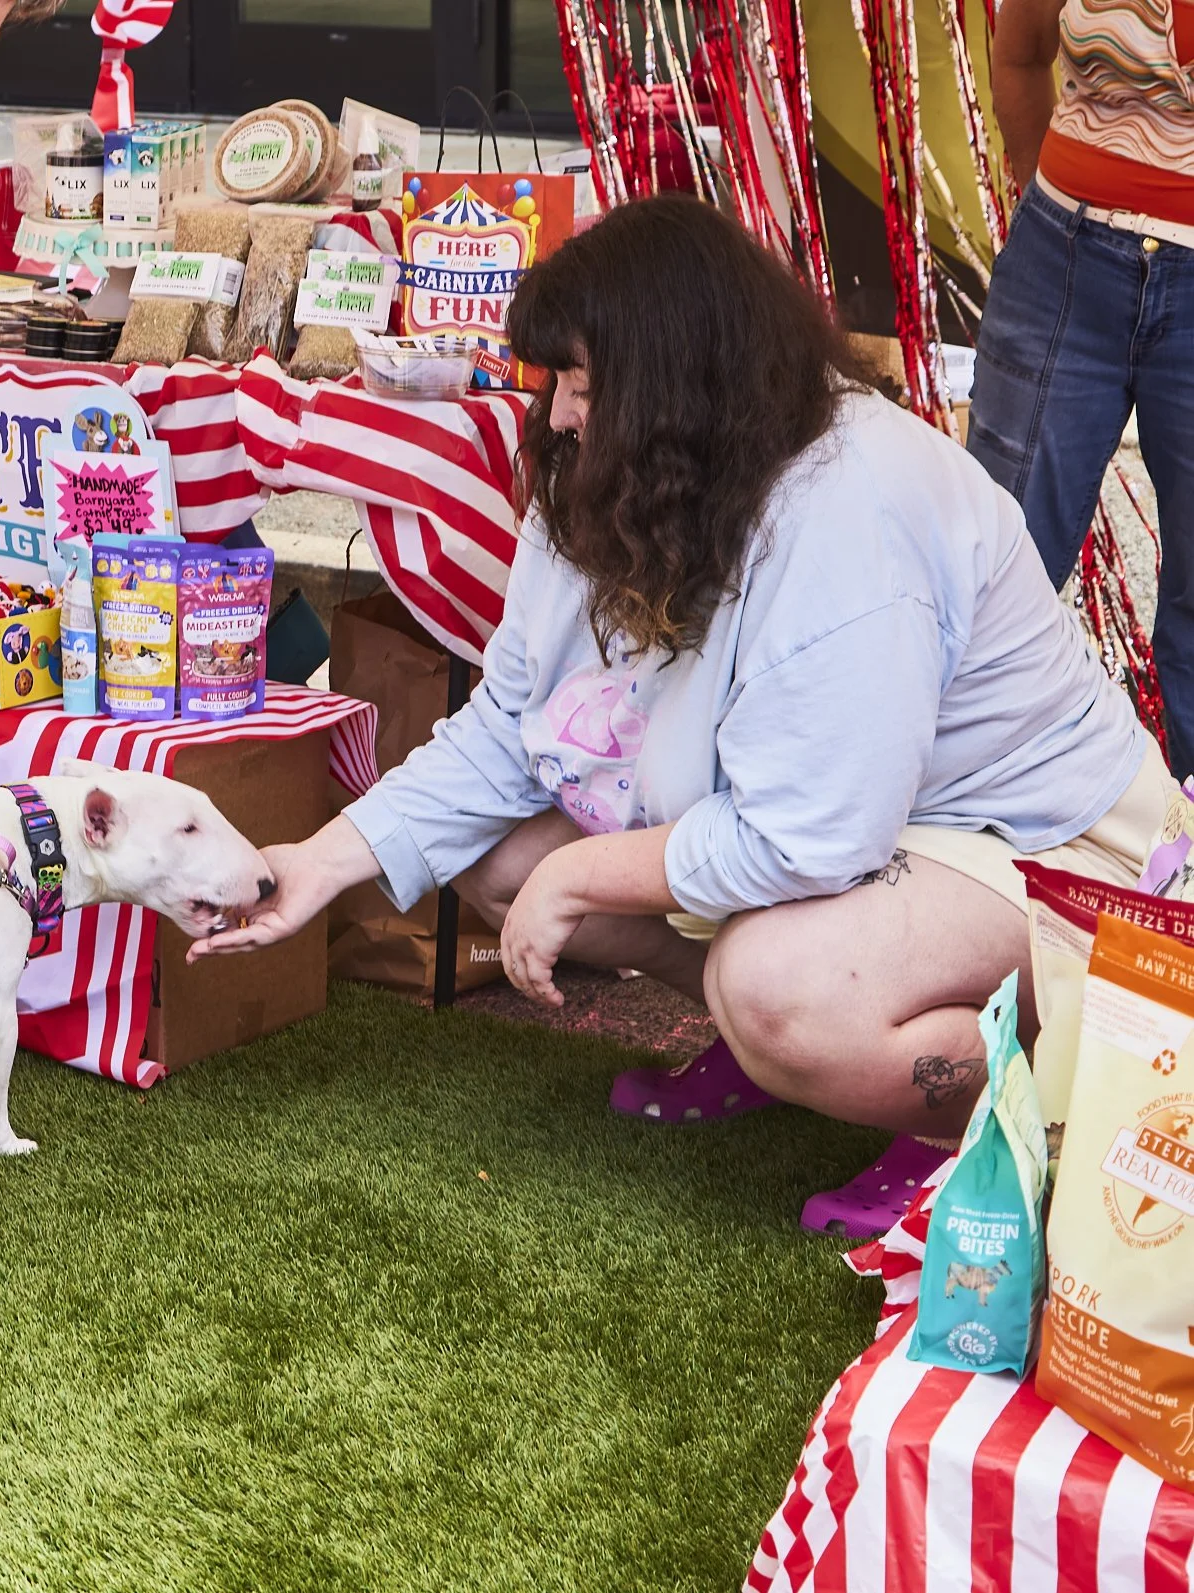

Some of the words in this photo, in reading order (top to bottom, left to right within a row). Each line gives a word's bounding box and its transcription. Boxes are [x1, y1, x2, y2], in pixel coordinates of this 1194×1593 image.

[251, 148, 281, 162] Field
[114, 180, 129, 188] LIX
[141, 181, 156, 189] LIX
[438, 241, 497, 258] HERE
[450, 258, 462, 268] for
[464, 260, 476, 268] the
[170, 267, 199, 280] Field
[348, 270, 381, 284] Field
[414, 268, 517, 294] CARNIVAL
[339, 300, 371, 313] Field
[430, 297, 502, 324] FUN
[482, 356, 502, 372] TICKET
[74, 492, 136, 510] Barnyard
[75, 508, 112, 522] Catnip
[208, 591, 245, 603] WERUVA
[106, 601, 128, 612] FREEZE
[130, 604, 152, 613] DRIED
[200, 608, 230, 618] FREEZE
[232, 608, 253, 616] DRIED
[107, 622, 148, 633] CHICKEN
[186, 620, 235, 631] MIDEAST
[237, 618, 257, 629] FEA
[122, 689, 146, 698] COOKED
[207, 692, 226, 700] FULLY
[228, 690, 248, 699] COOKED
[1068, 886, 1099, 910] RAW
[1105, 901, 1166, 932] FREEZE
[1107, 891, 1121, 902] FOR
[1124, 897, 1146, 908] YOUR
[1167, 910, 1186, 920] AND
[1153, 949, 1174, 963] GOOD
[1136, 954, 1166, 977] RAW
[1171, 968, 1194, 990] FRE
[1136, 1099, 1162, 1118] FOOD
[1162, 1093, 1185, 1105] THAT
[1140, 1132, 1194, 1169] STEVE
[1112, 1147, 1160, 1187] REAL
[947, 1216, 1020, 1240] PROTEIN
[1106, 1208, 1119, 1226] THE
[1136, 1241, 1150, 1250] THEY
[1150, 1232, 1174, 1249] WALK
[1173, 1222, 1185, 1236] ON
[958, 1236, 1006, 1256] BITES
[1052, 1267, 1102, 1312] PORK
[1050, 1295, 1111, 1350] RECIPE
[1071, 1337, 1086, 1352] with
[1087, 1344, 1101, 1360] Raw
[1101, 1353, 1123, 1373] Goat's
[1124, 1364, 1141, 1381] Milk
[1049, 1360, 1060, 1378] Easy
[1060, 1373, 1068, 1382] to
[1068, 1376, 1100, 1402] Rehydrate
[1102, 1395, 1131, 1420] Nuggets
[1051, 1346, 1058, 1359] No
[1058, 1355, 1074, 1374] Added
[1076, 1368, 1112, 1394] Antibiotics
[1112, 1390, 1120, 1399] or
[1122, 1394, 1161, 1420] Hormones
[1083, 1357, 1108, 1379] Species
[1109, 1372, 1154, 1401] Appropriate
[1155, 1393, 1179, 1408] Diet
